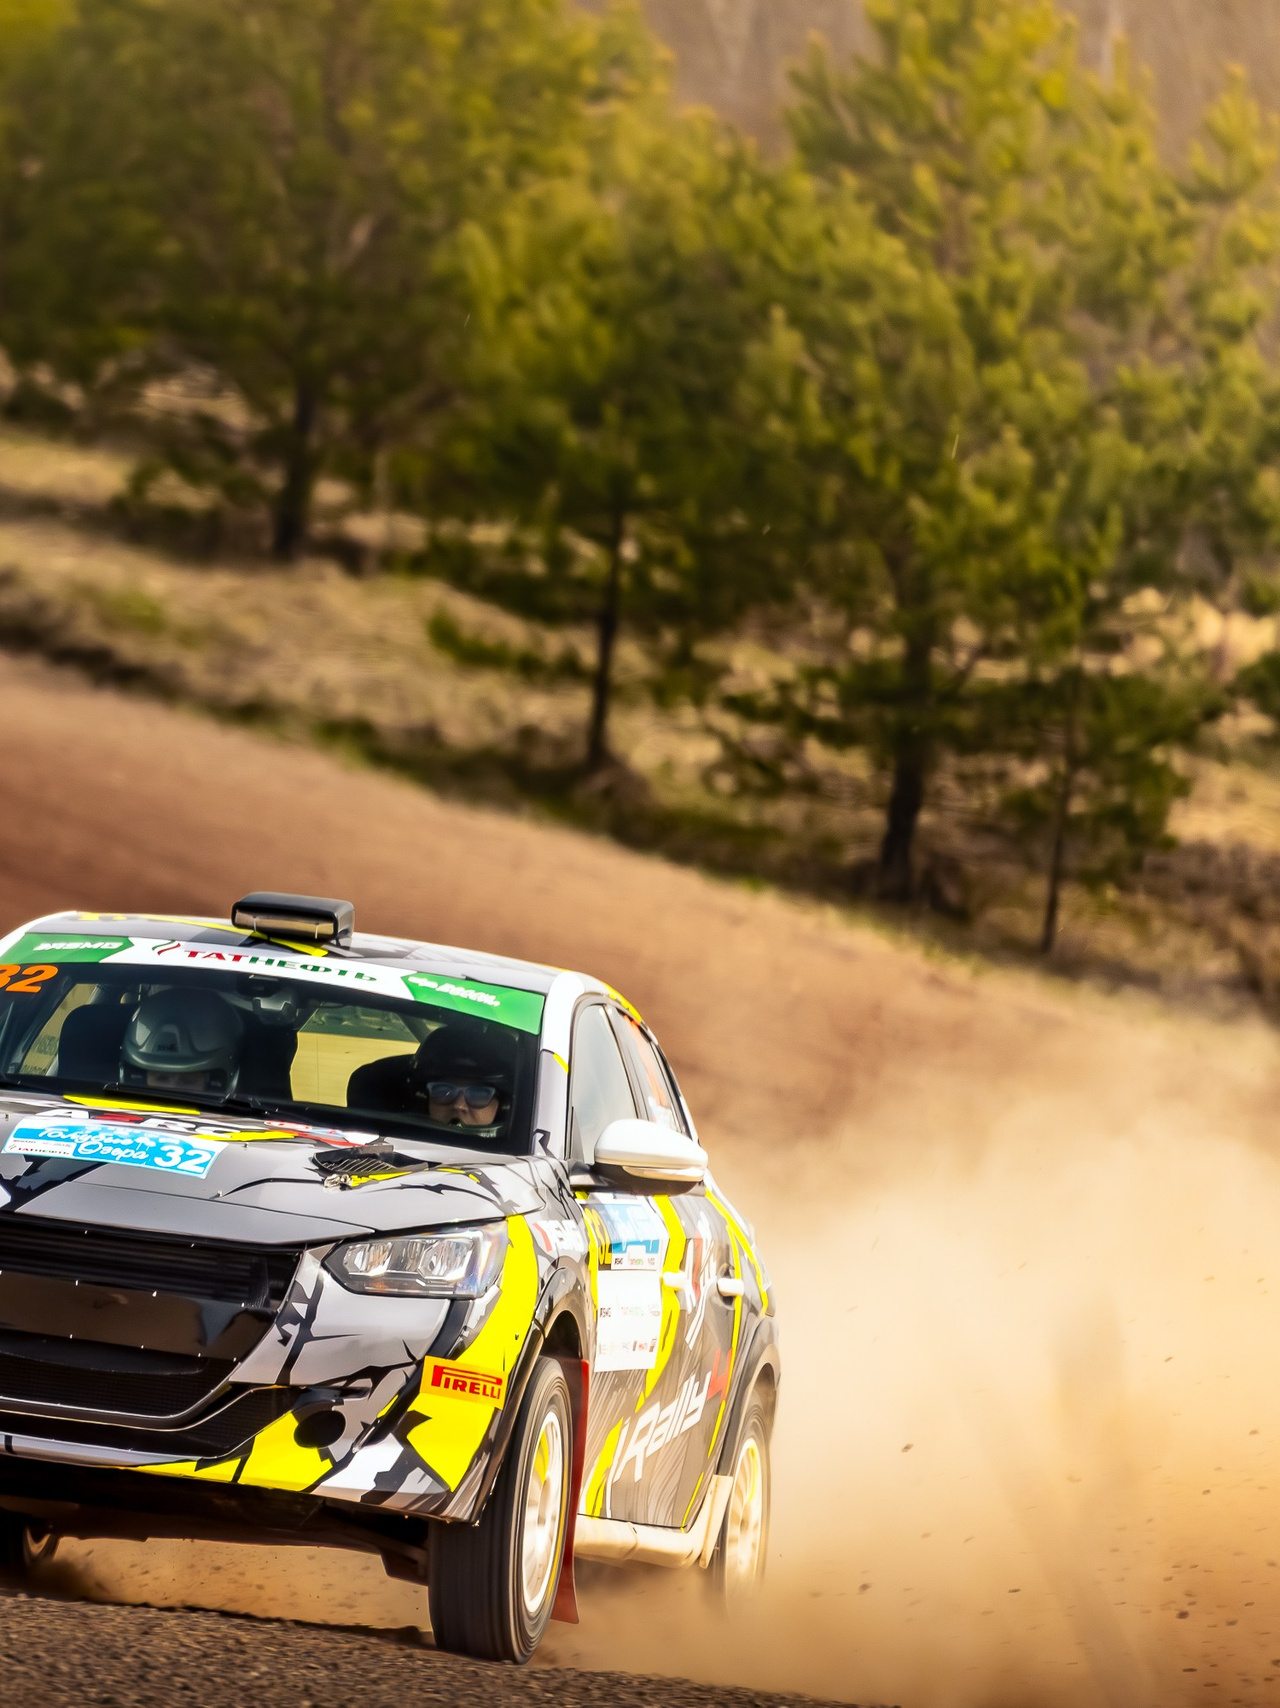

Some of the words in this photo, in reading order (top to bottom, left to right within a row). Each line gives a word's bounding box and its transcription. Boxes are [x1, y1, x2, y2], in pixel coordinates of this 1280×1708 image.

[183, 950, 378, 982] ТАТНЕФТЬ
[154, 1144, 213, 1174] 32
[431, 1365, 503, 1400] PIRELLI
